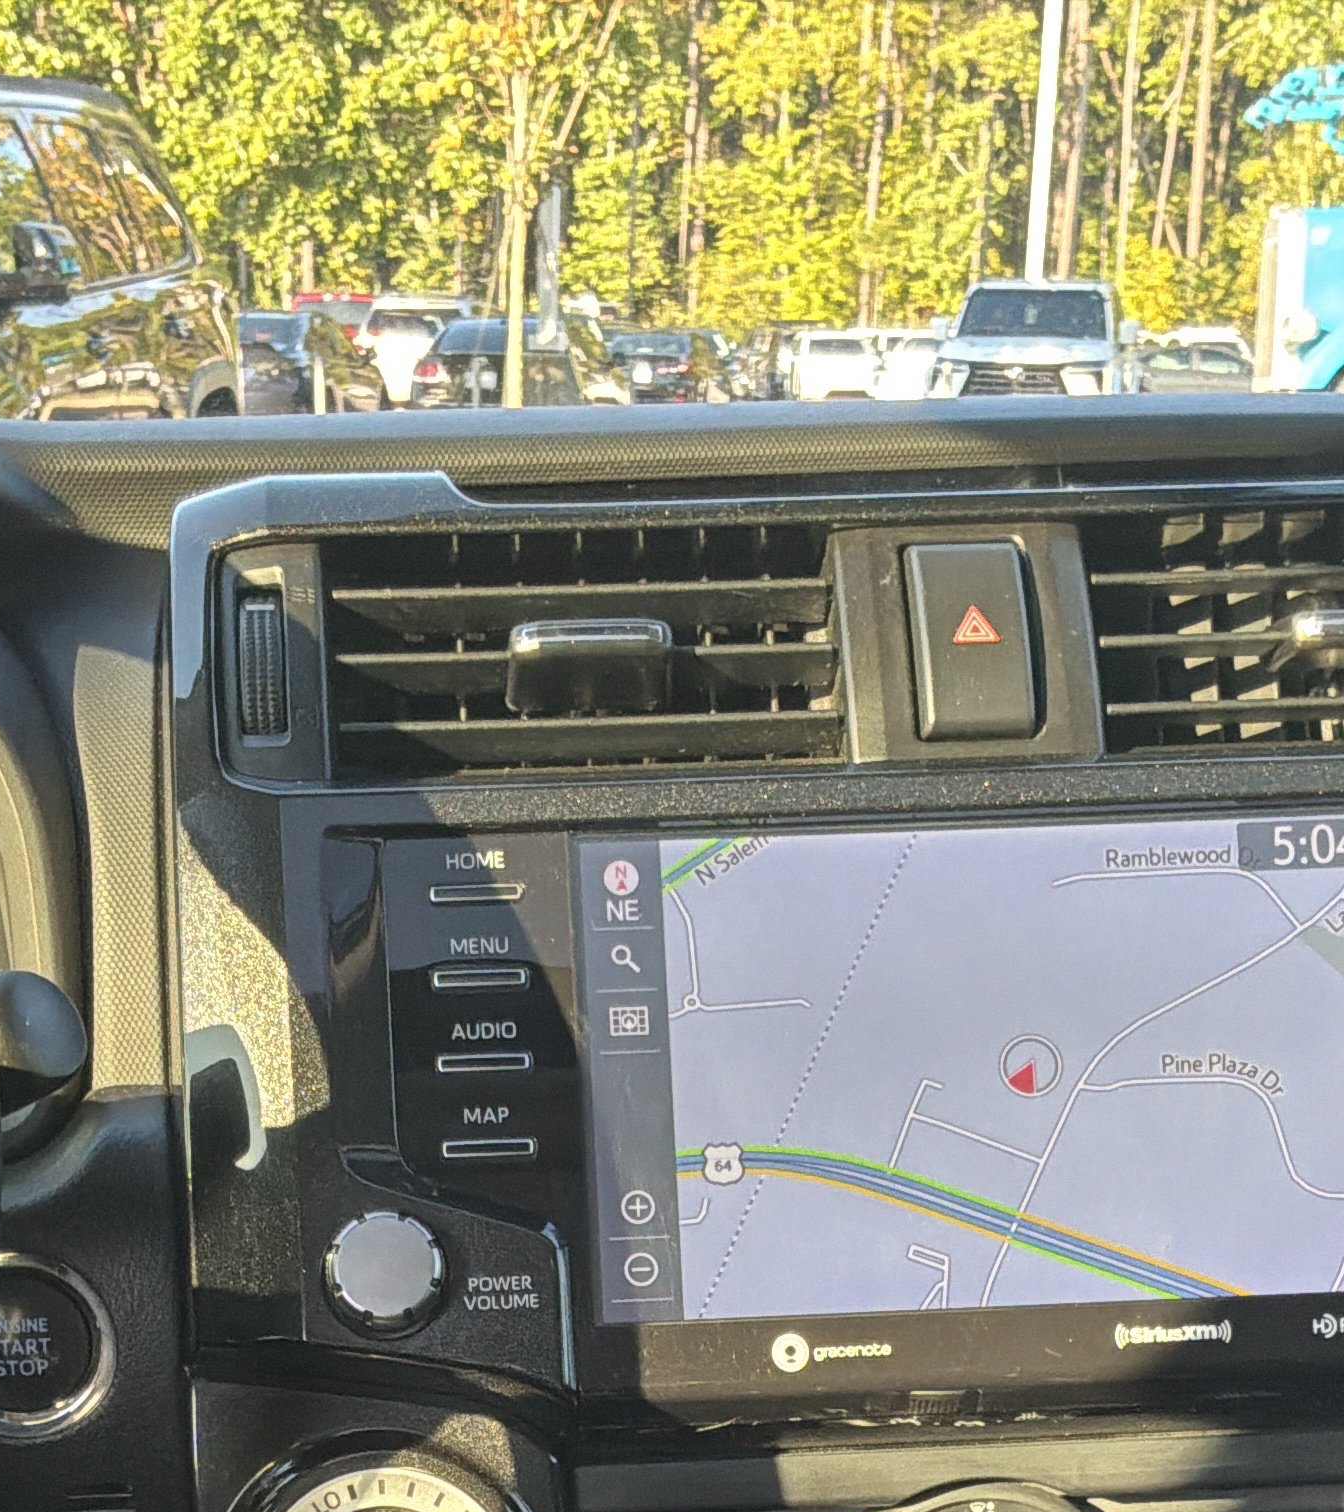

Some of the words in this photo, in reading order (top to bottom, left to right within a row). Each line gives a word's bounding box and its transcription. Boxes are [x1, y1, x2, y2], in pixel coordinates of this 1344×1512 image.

[445, 850, 506, 870] HOME
[1106, 844, 1232, 868] Ramblewood
[694, 862, 716, 886] N
[606, 899, 641, 922] NE
[450, 936, 509, 956] MENU
[451, 1020, 517, 1041] AUDIO
[1161, 1053, 1203, 1074] Pine
[1207, 1053, 1259, 1078] Plaza
[1258, 1070, 1284, 1098] Dr
[463, 1106, 510, 1125] MAP
[714, 1159, 733, 1173] 64
[467, 1274, 534, 1292] POWER
[463, 1292, 540, 1311] VOLUME
